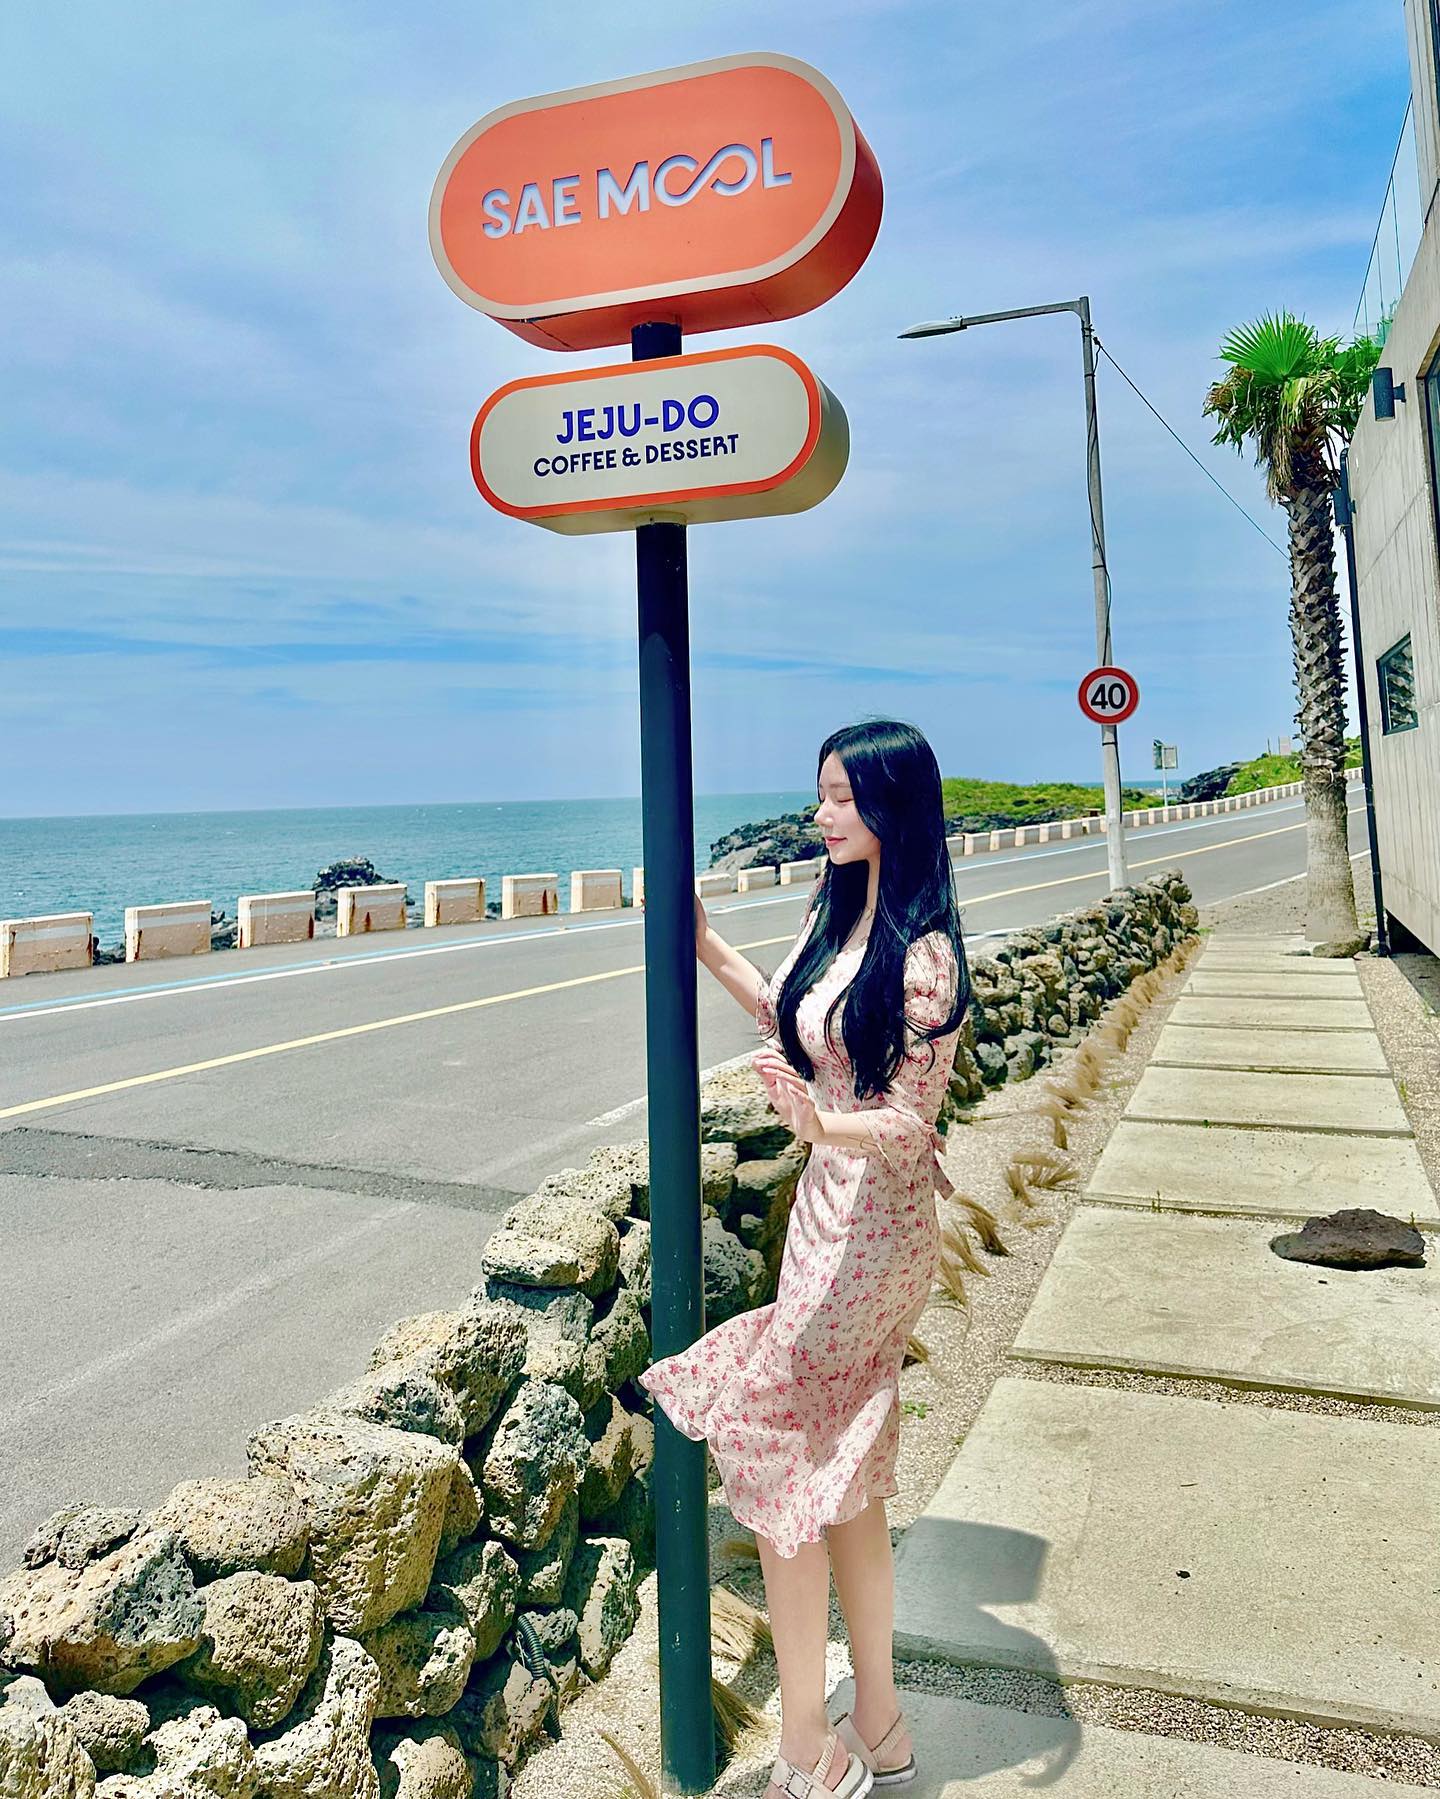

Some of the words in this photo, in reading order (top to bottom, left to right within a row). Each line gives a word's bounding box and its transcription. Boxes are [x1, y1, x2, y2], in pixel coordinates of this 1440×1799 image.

[481, 174, 583, 240] SAE
[597, 137, 793, 219] MOOL
[556, 394, 720, 445] JEJU-DO
[533, 448, 617, 477] COFFEE
[621, 447, 642, 467] &
[645, 433, 739, 465] DESSERT
[1090, 683, 1126, 710] 40
